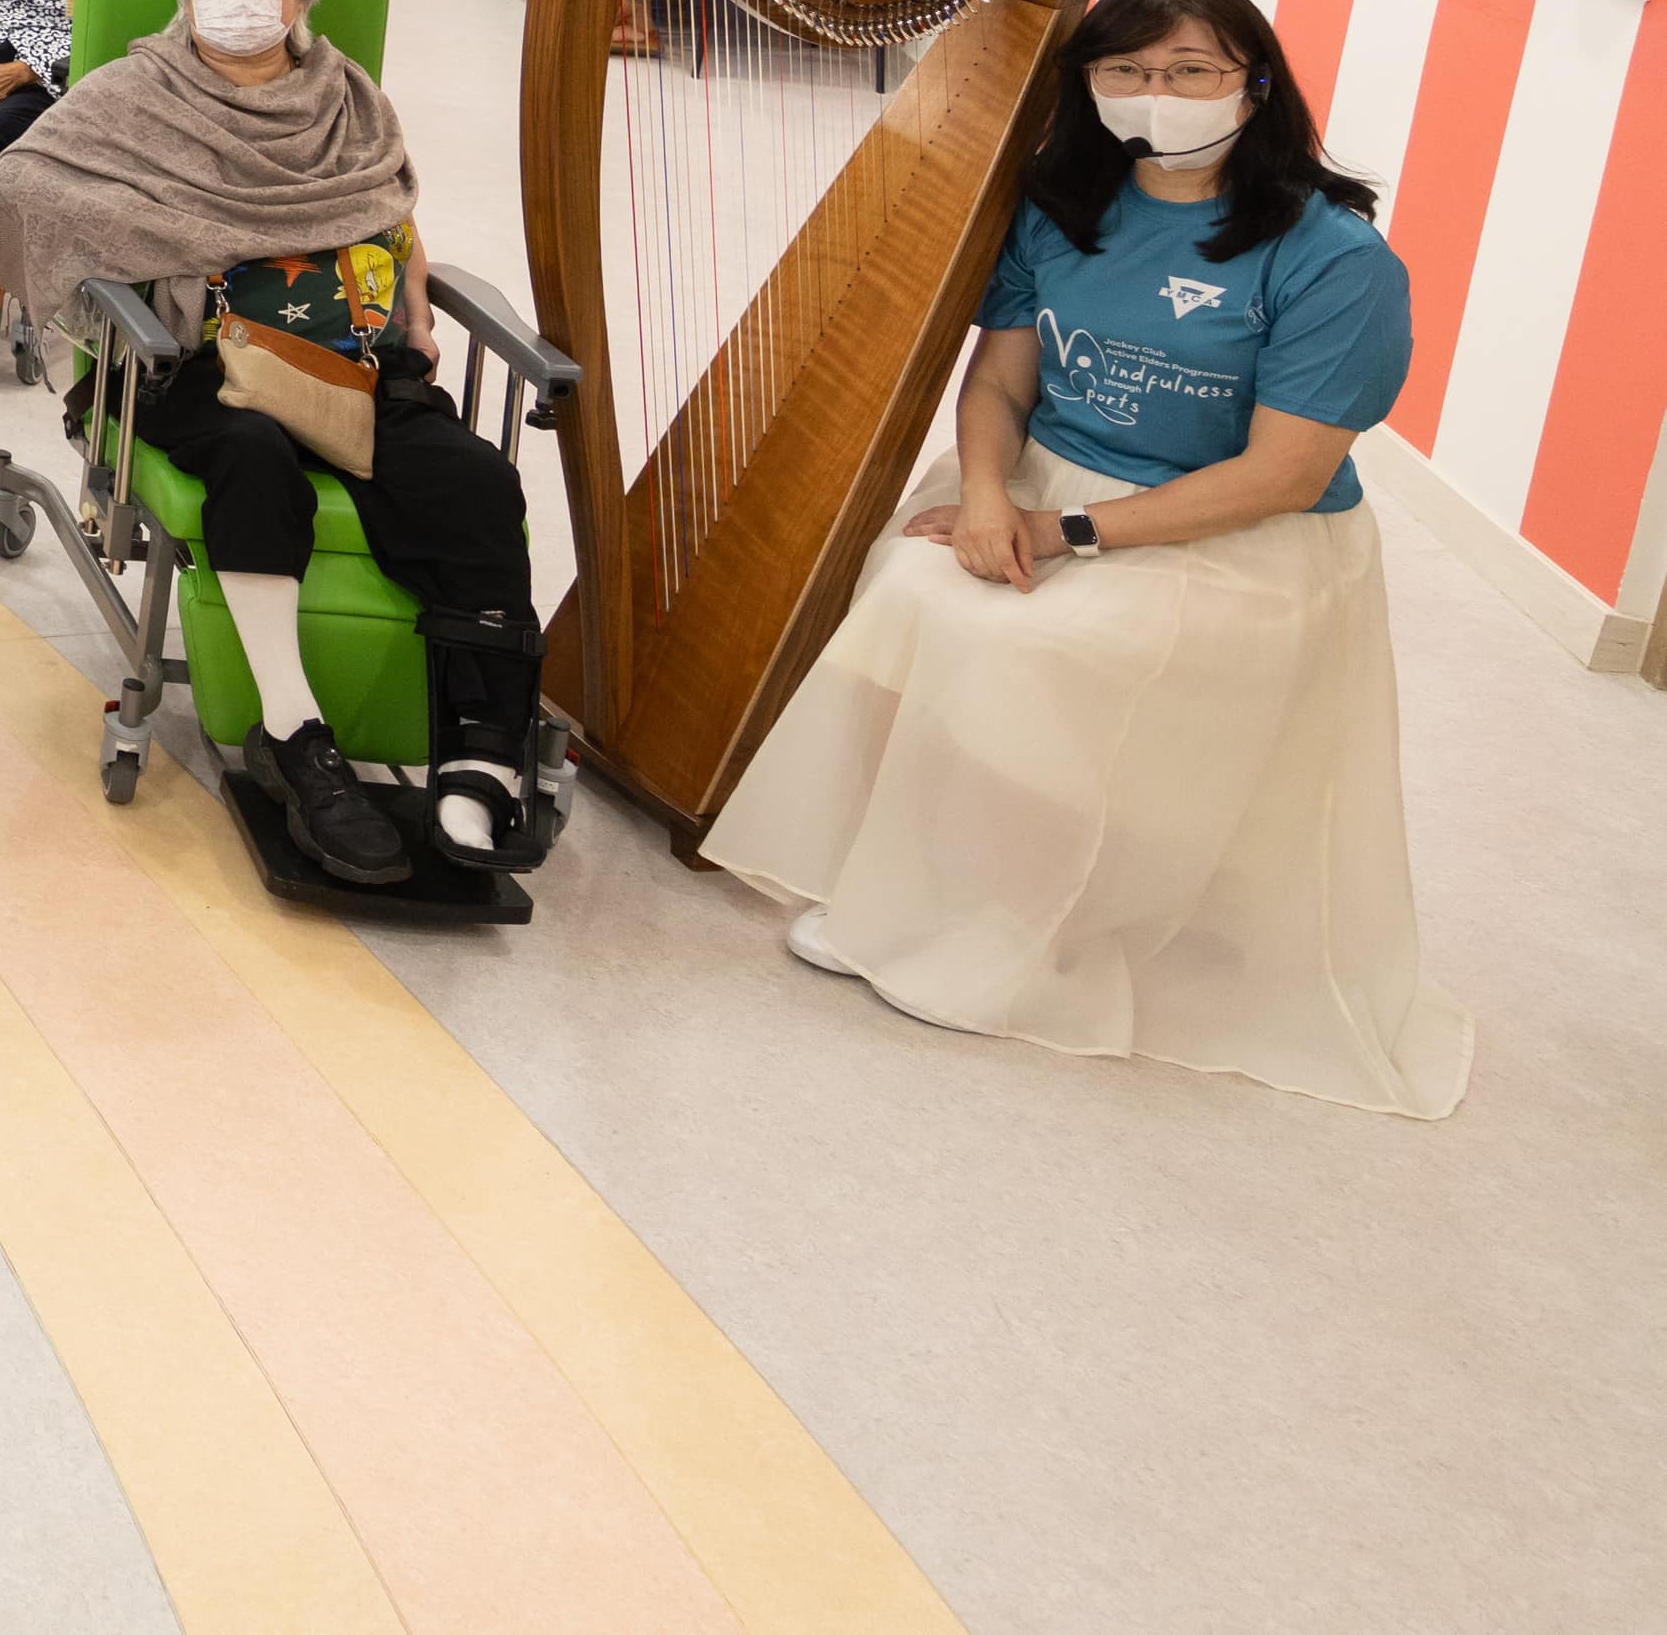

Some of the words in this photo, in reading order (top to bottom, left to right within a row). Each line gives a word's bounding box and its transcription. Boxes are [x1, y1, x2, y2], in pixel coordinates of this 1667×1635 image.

[1166, 288, 1213, 306] YMCA
[1104, 339, 1140, 352] Jockey
[1141, 346, 1167, 358] Club
[1105, 347, 1138, 361] Active
[1138, 355, 1170, 369] Elders
[1171, 363, 1240, 381] Programme
[1103, 377, 1142, 394] through
